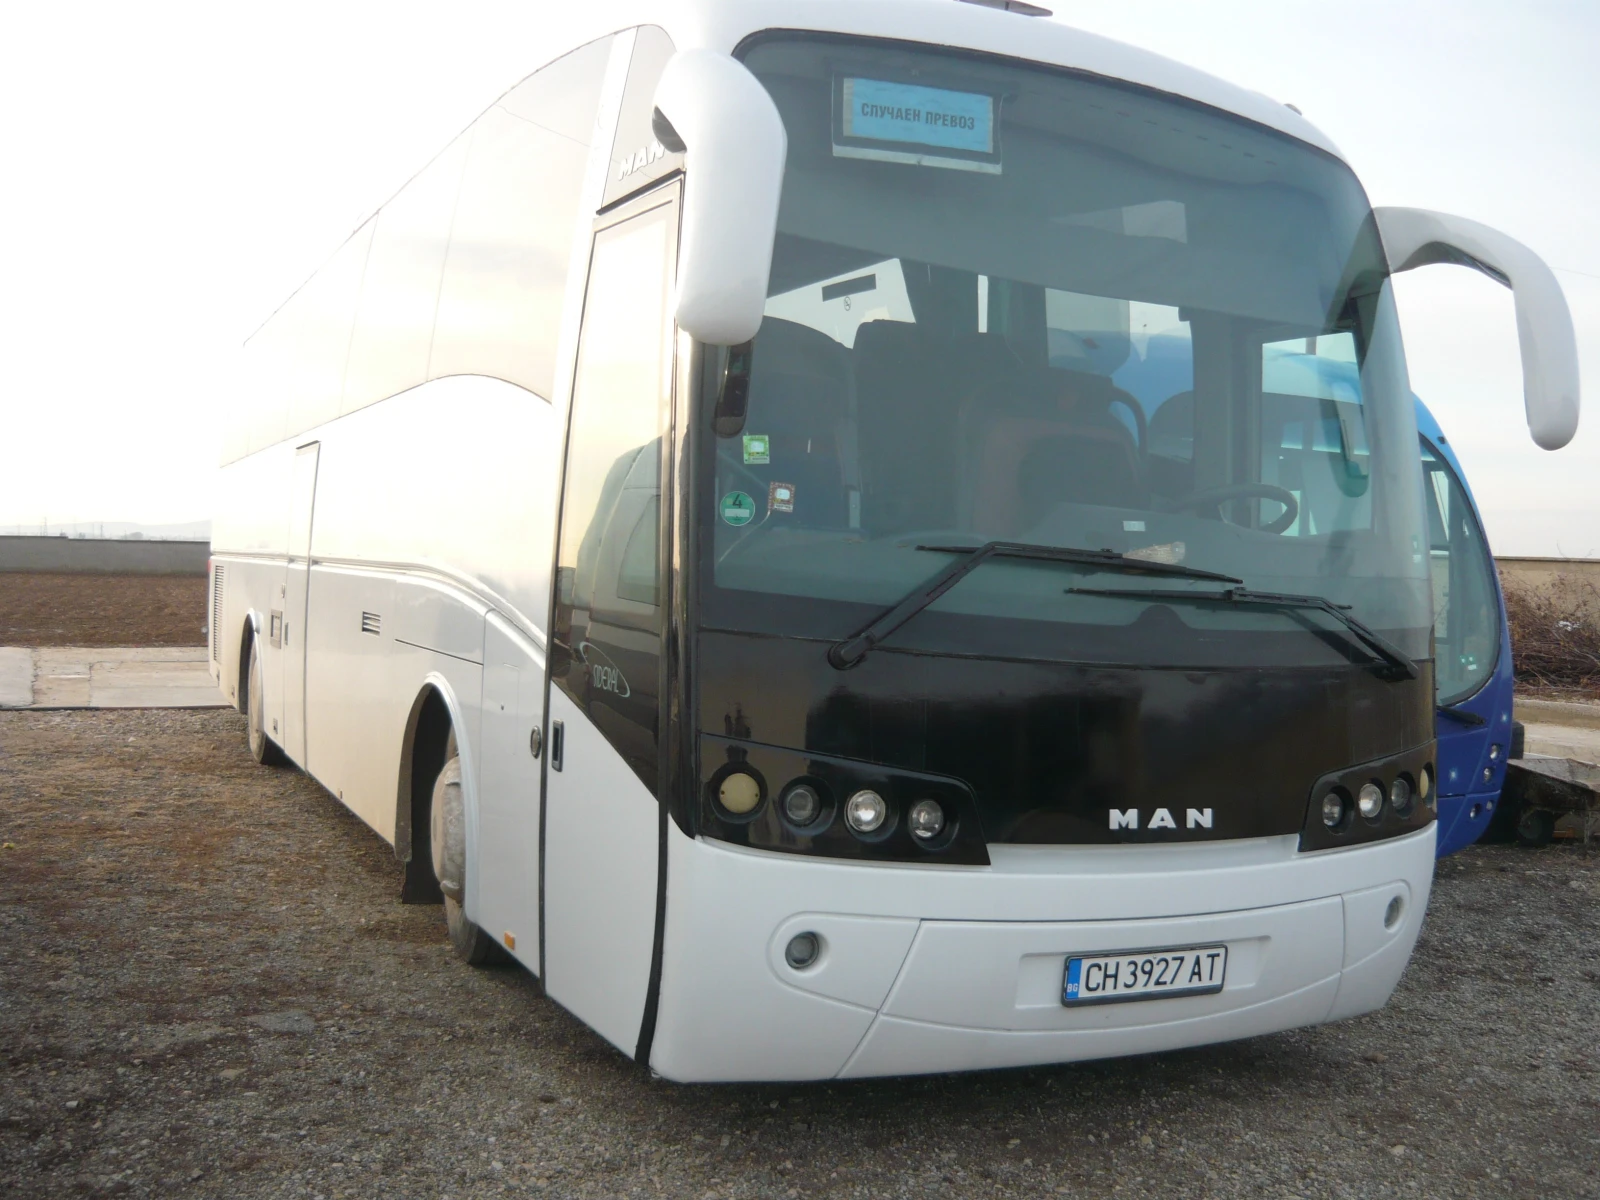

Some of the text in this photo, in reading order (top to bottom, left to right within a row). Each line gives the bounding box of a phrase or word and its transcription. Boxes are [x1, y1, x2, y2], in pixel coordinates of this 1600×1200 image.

[861, 102, 975, 130] СЛУЧАЕН ПРЕВОЗ
[618, 140, 666, 182] MAN
[732, 493, 743, 509] 4
[1108, 808, 1213, 830] MAN
[1066, 982, 1079, 993] BG
